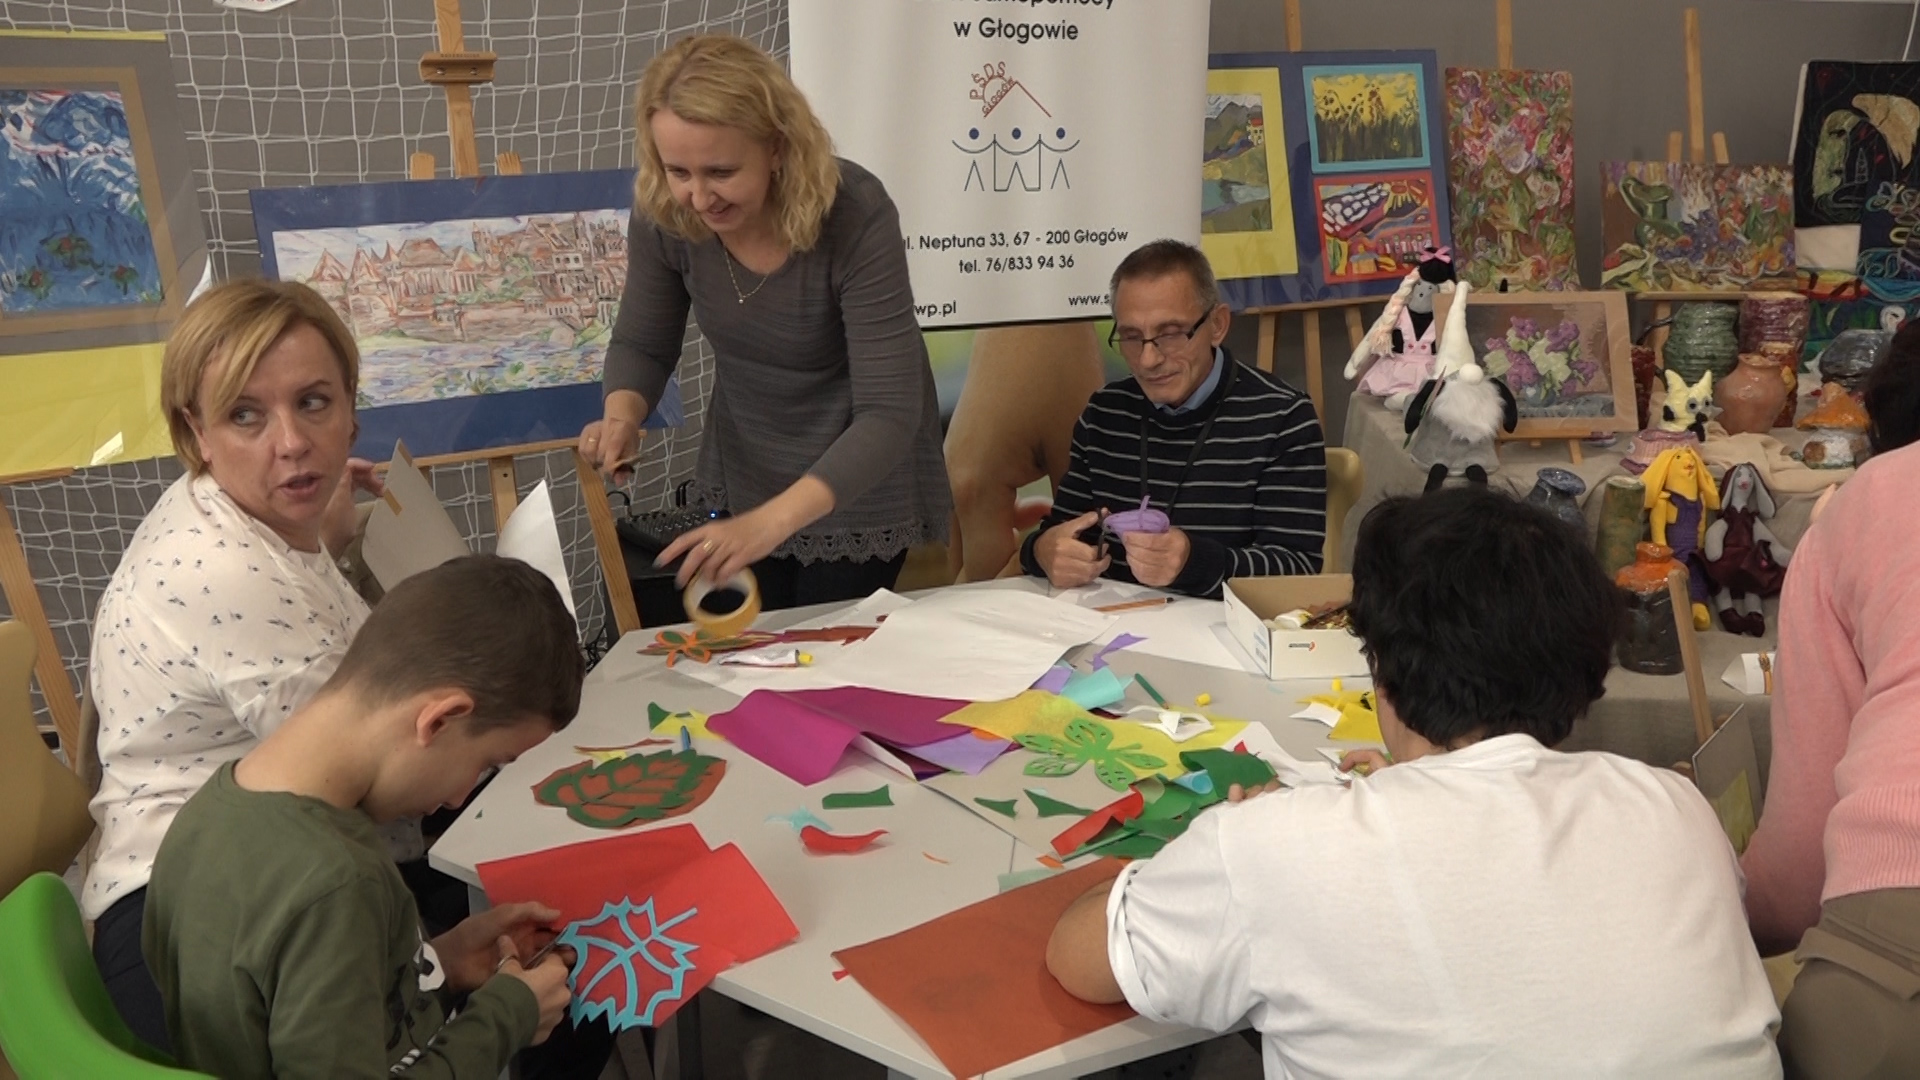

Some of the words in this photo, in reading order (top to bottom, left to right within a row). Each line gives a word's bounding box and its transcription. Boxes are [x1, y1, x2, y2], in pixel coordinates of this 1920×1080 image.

[952, 21, 972, 38] w
[978, 17, 1079, 44] Głogowie
[919, 234, 986, 252] Neptuna
[989, 232, 1010, 248] 33,
[1012, 231, 1031, 246] 67
[1045, 230, 1071, 245] 200
[1073, 227, 1129, 247] Głogów
[958, 259, 982, 274] tel.
[985, 256, 1034, 274] 76/833
[1036, 255, 1055, 270] 94
[1058, 254, 1075, 269] 36
